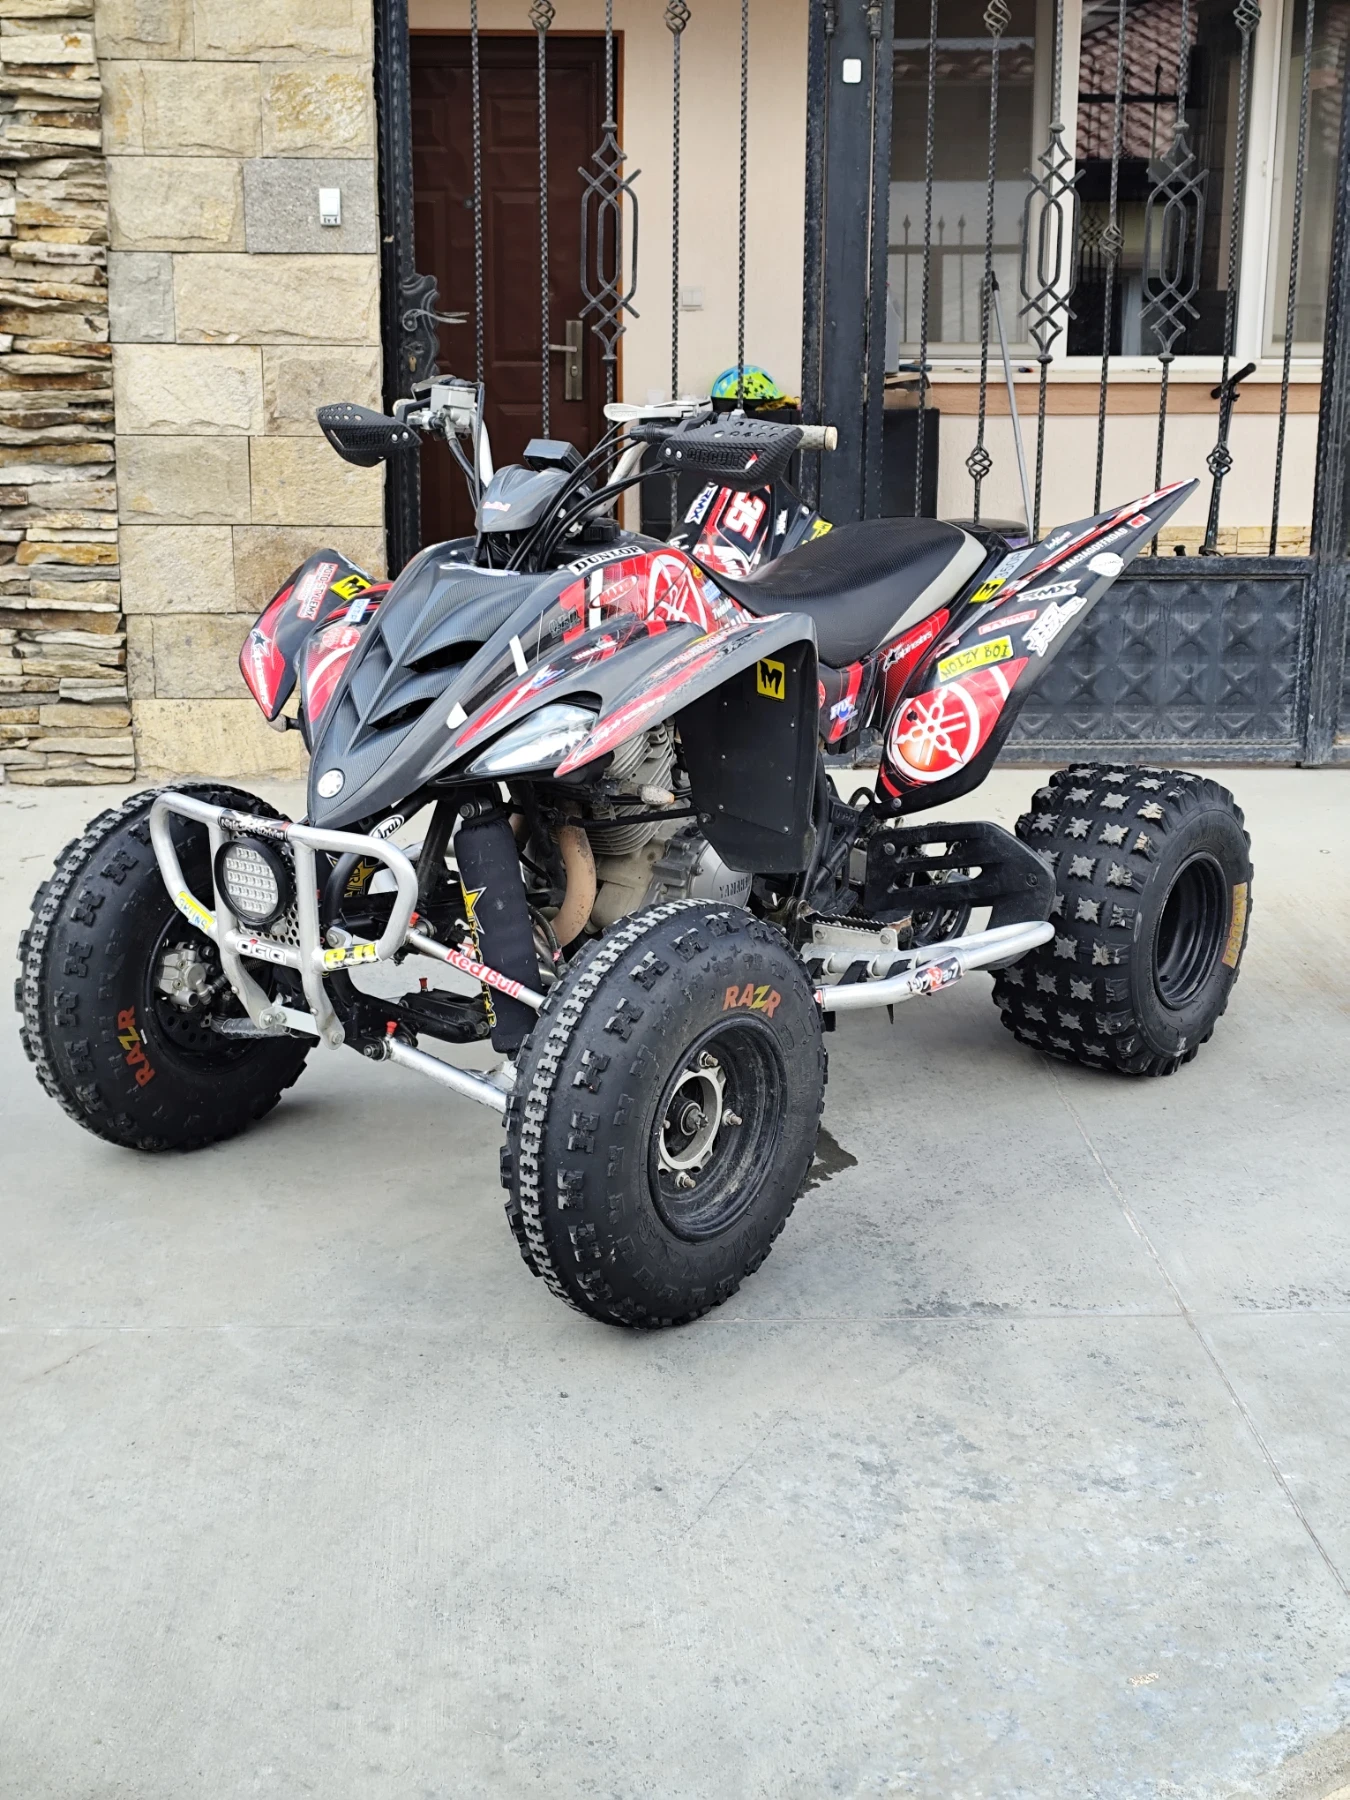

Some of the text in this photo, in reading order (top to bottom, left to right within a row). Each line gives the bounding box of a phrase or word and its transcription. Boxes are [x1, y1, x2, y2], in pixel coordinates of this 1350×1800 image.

[687, 448, 744, 467] CIRCUIT
[573, 546, 640, 573] DUNLOP
[941, 644, 1010, 678] NOIZY BOI
[446, 949, 524, 998] Red Bull
[722, 983, 782, 1019] RAZR
[117, 1005, 156, 1088] RAZR
